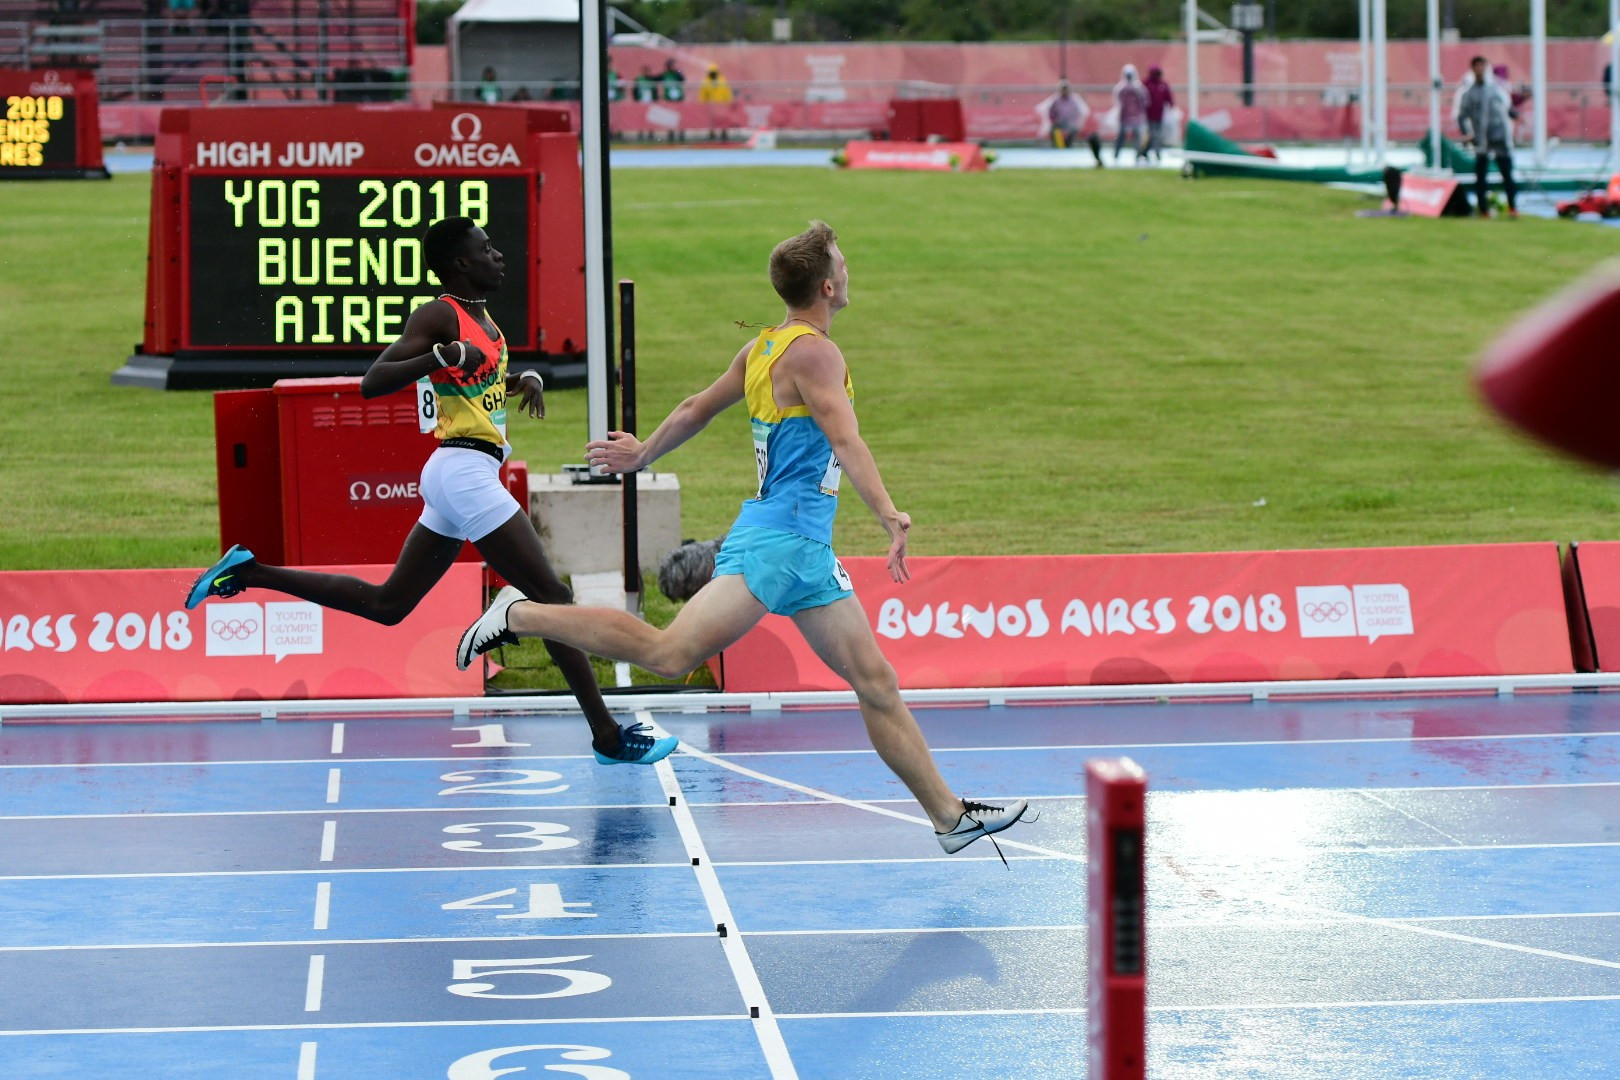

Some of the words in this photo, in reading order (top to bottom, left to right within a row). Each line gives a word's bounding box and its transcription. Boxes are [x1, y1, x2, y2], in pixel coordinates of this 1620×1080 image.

[196, 141, 272, 168] HIGH
[277, 141, 365, 168] JUMP
[413, 143, 521, 168] OMEGA
[224, 179, 320, 228] YOG
[359, 179, 489, 228] 2018
[258, 237, 442, 286] BUENO
[422, 389, 435, 419] 8
[375, 482, 423, 499] OME
[836, 561, 849, 582] 4
[1360, 605, 1406, 616] OLYMPIC
[1363, 593, 1400, 603] YOUTH
[270, 623, 318, 634] OLYMPIC
[275, 611, 313, 621] YOUTH
[876, 597, 1050, 640] BUENOS
[1060, 597, 1177, 637] AIRES
[1186, 593, 1287, 635] 2018
[1366, 616, 1403, 627] GAMES
[87, 611, 193, 653] 2018
[275, 636, 313, 646] GAMES
[450, 724, 531, 748] 1
[438, 769, 570, 796] 2
[441, 821, 580, 853] 3
[441, 883, 598, 919] 4
[446, 954, 613, 999] 5
[447, 1044, 632, 1080] 6
